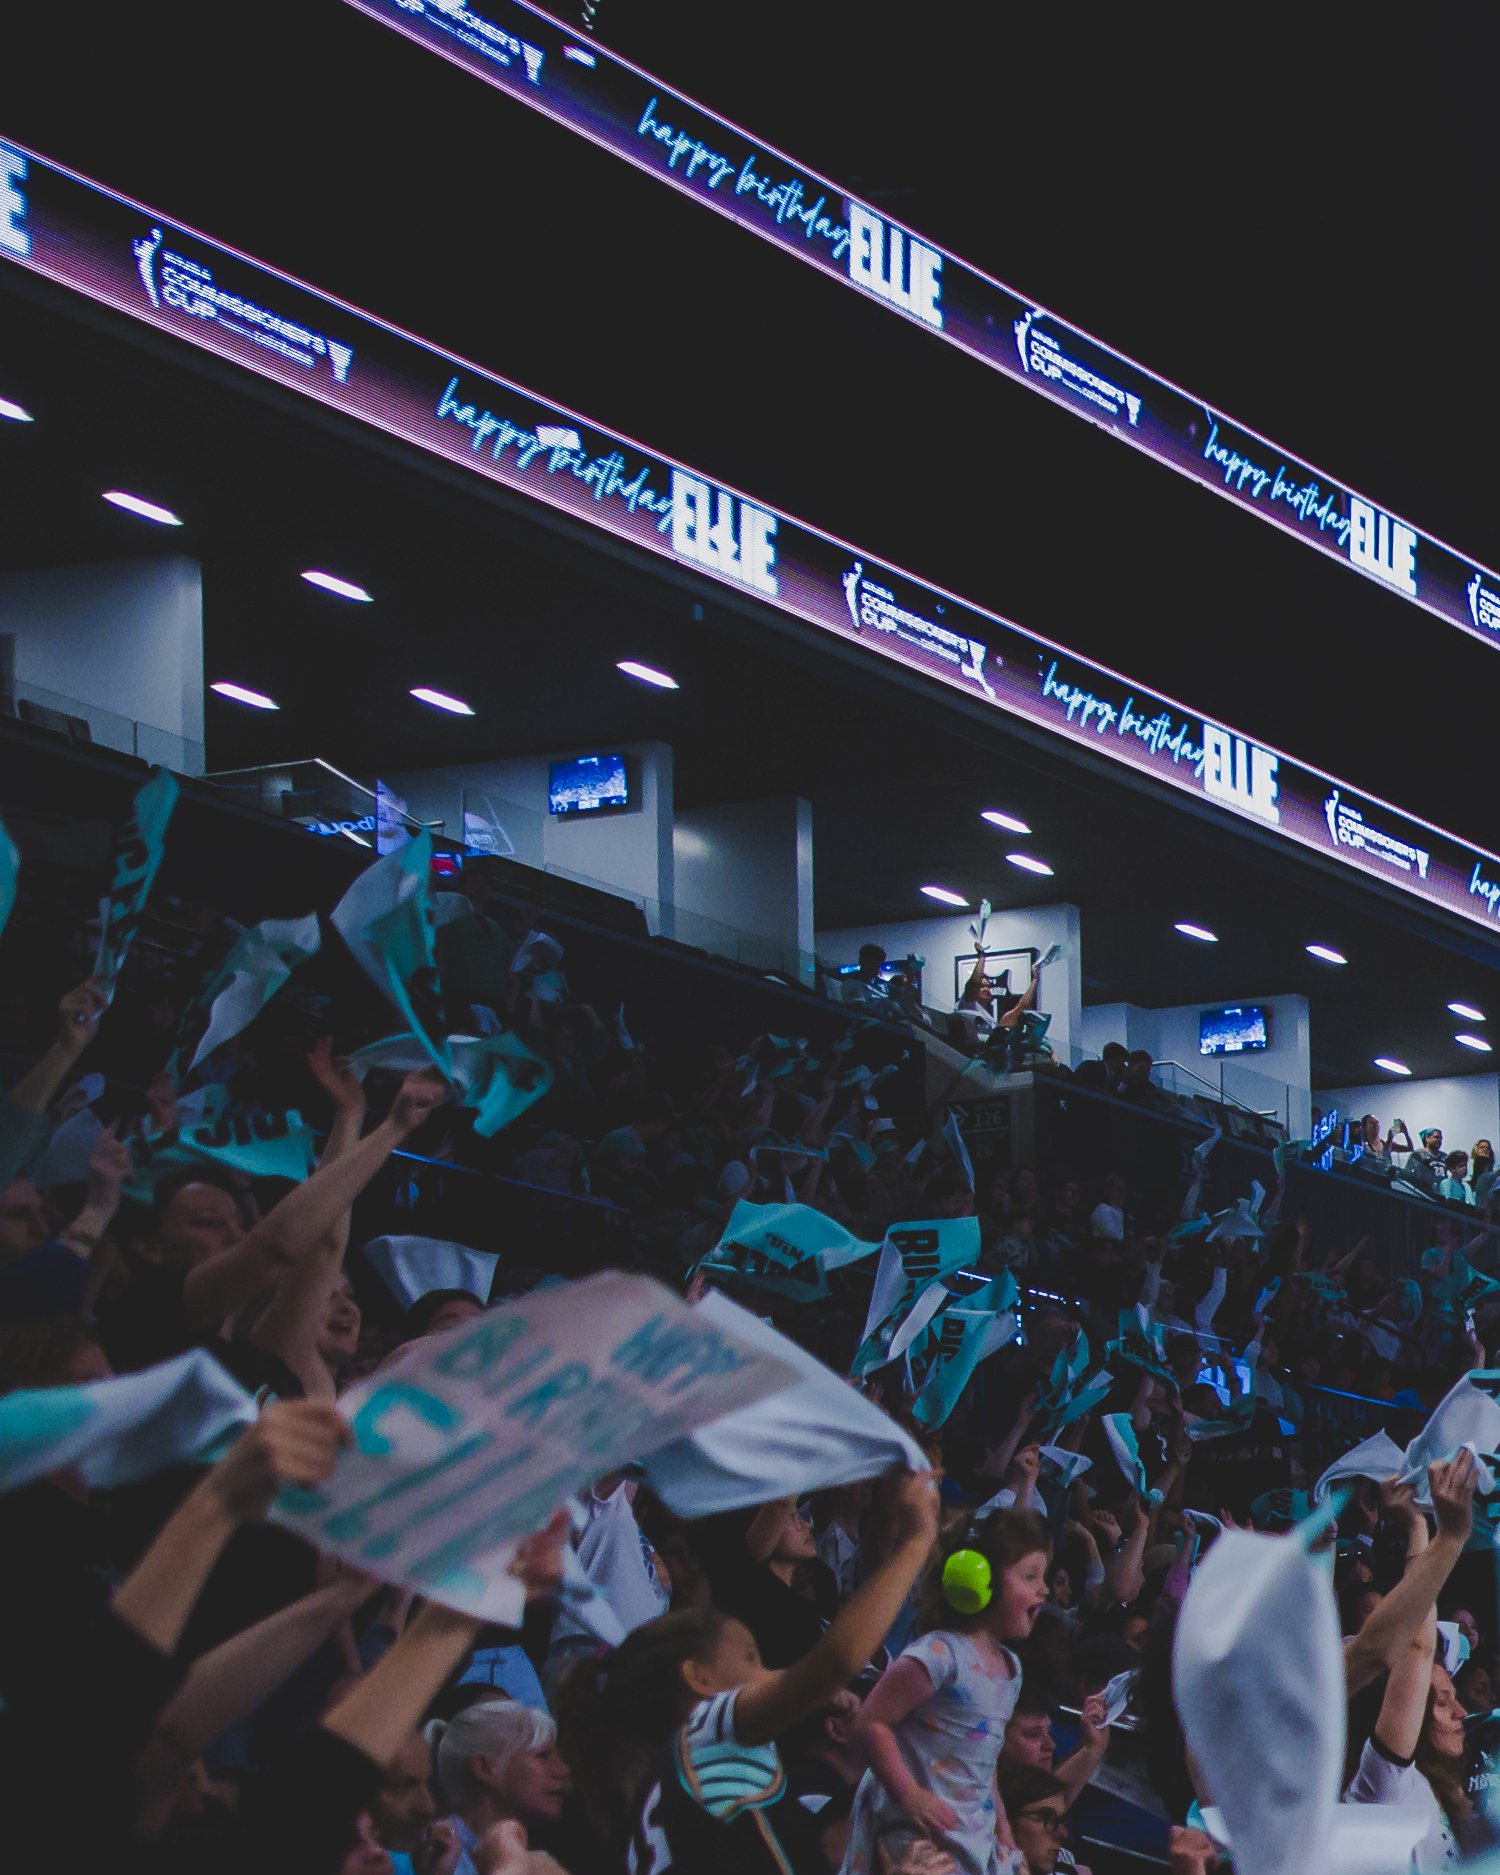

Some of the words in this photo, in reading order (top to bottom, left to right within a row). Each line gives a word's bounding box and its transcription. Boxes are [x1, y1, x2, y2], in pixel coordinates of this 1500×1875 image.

[637, 98, 733, 189] happy
[736, 155, 850, 260] birthday
[849, 200, 944, 332] ELLIE
[436, 376, 545, 470] happy
[672, 470, 779, 598] ELLIE
[1204, 422, 1268, 498] happy
[1270, 468, 1351, 546] birthday
[1350, 496, 1417, 597] ELLIE
[1041, 661, 1118, 736] happy
[1118, 697, 1204, 779] birthday
[1203, 722, 1280, 826] ELLIE
